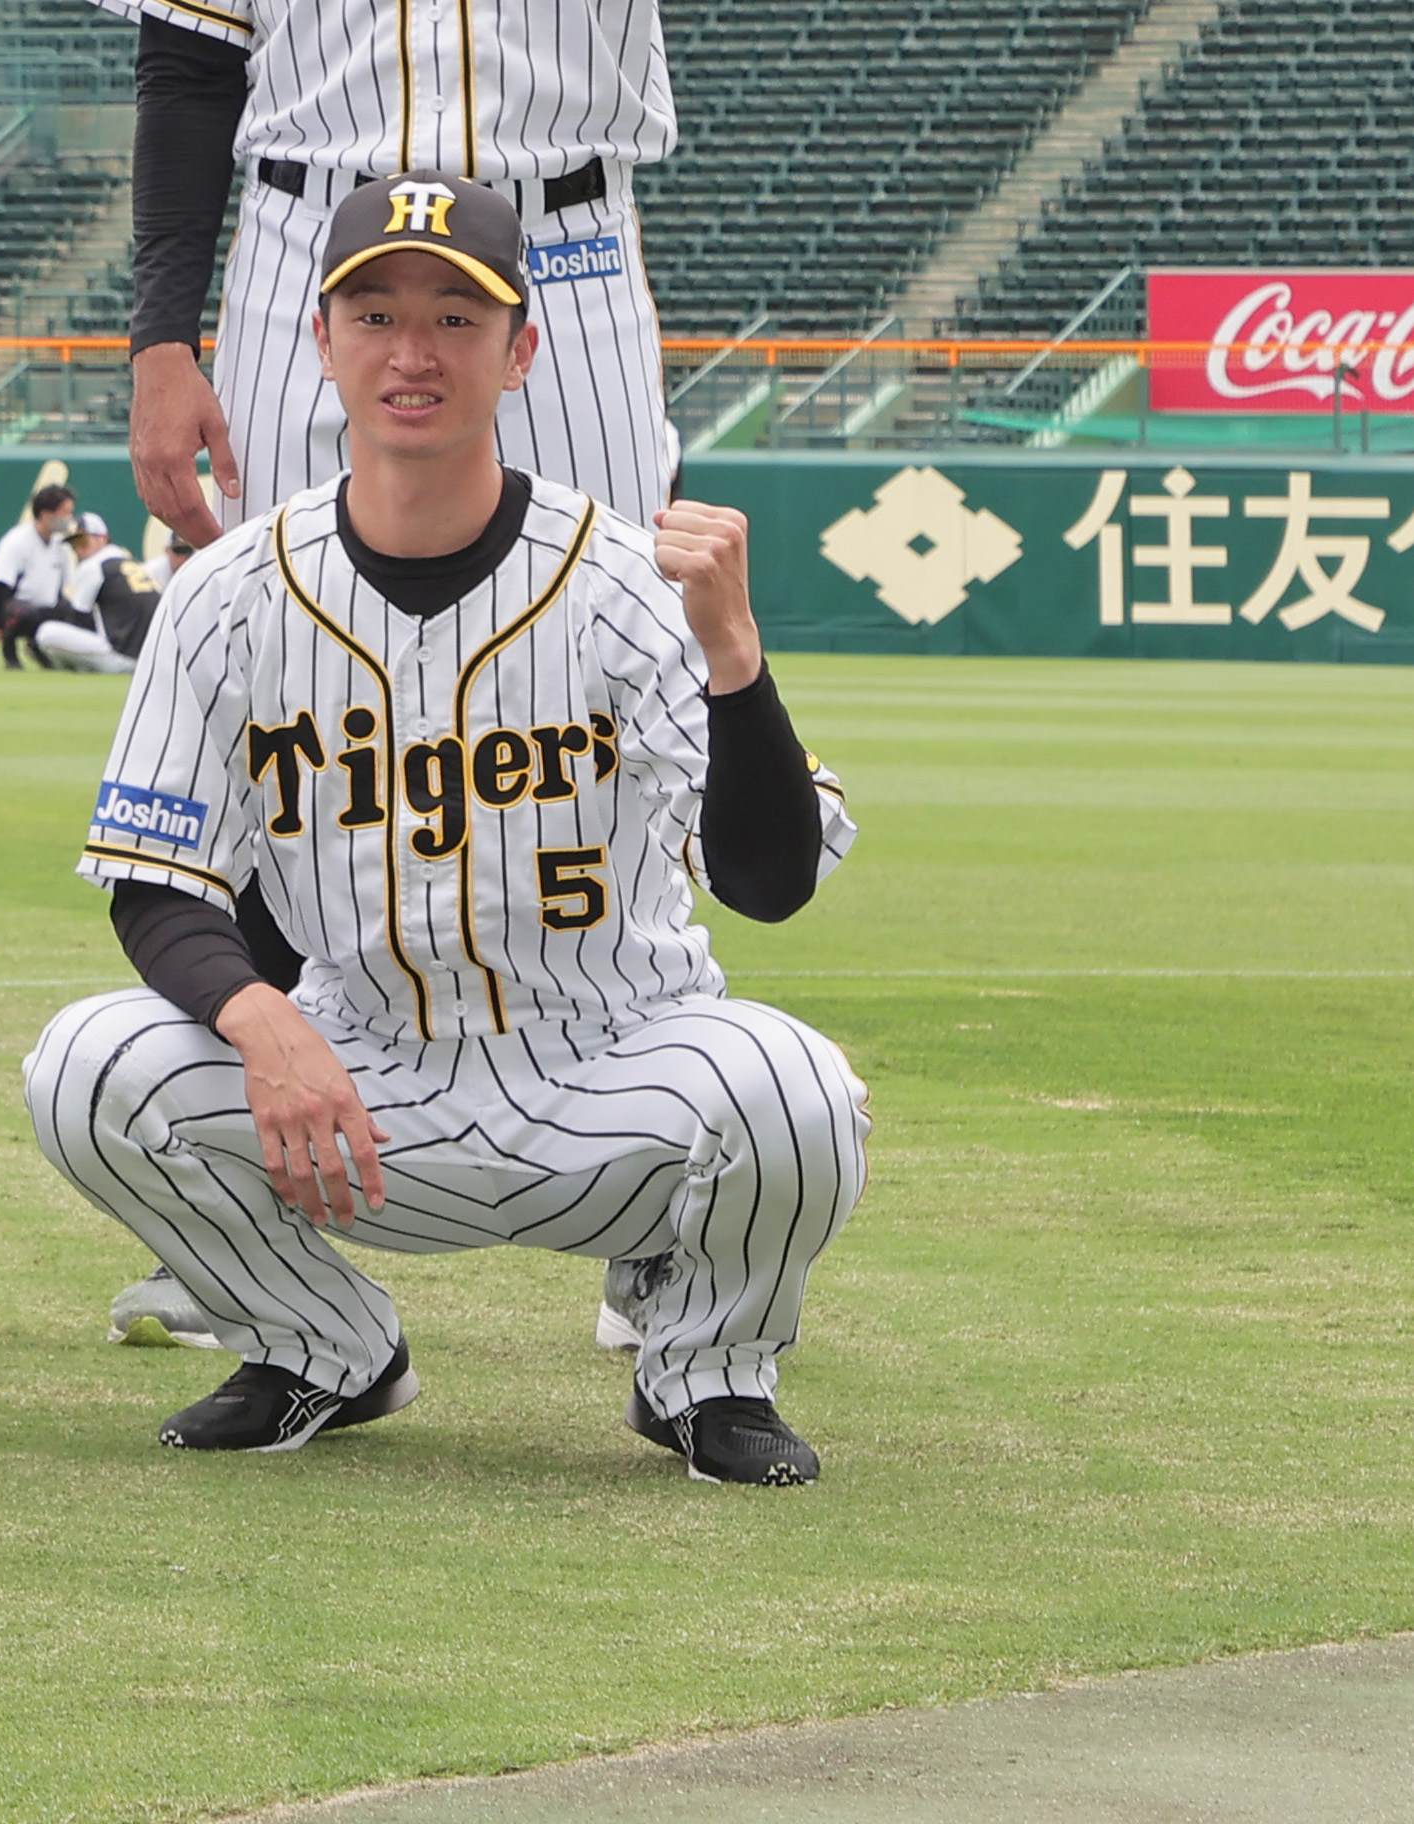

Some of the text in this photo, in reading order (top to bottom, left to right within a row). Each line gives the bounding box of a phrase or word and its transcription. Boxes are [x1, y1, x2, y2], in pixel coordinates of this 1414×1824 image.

[531, 241, 621, 280] Joshin
[1063, 465, 1414, 632] 住友
[96, 787, 199, 840] Joshin
[537, 845, 608, 933] 5
